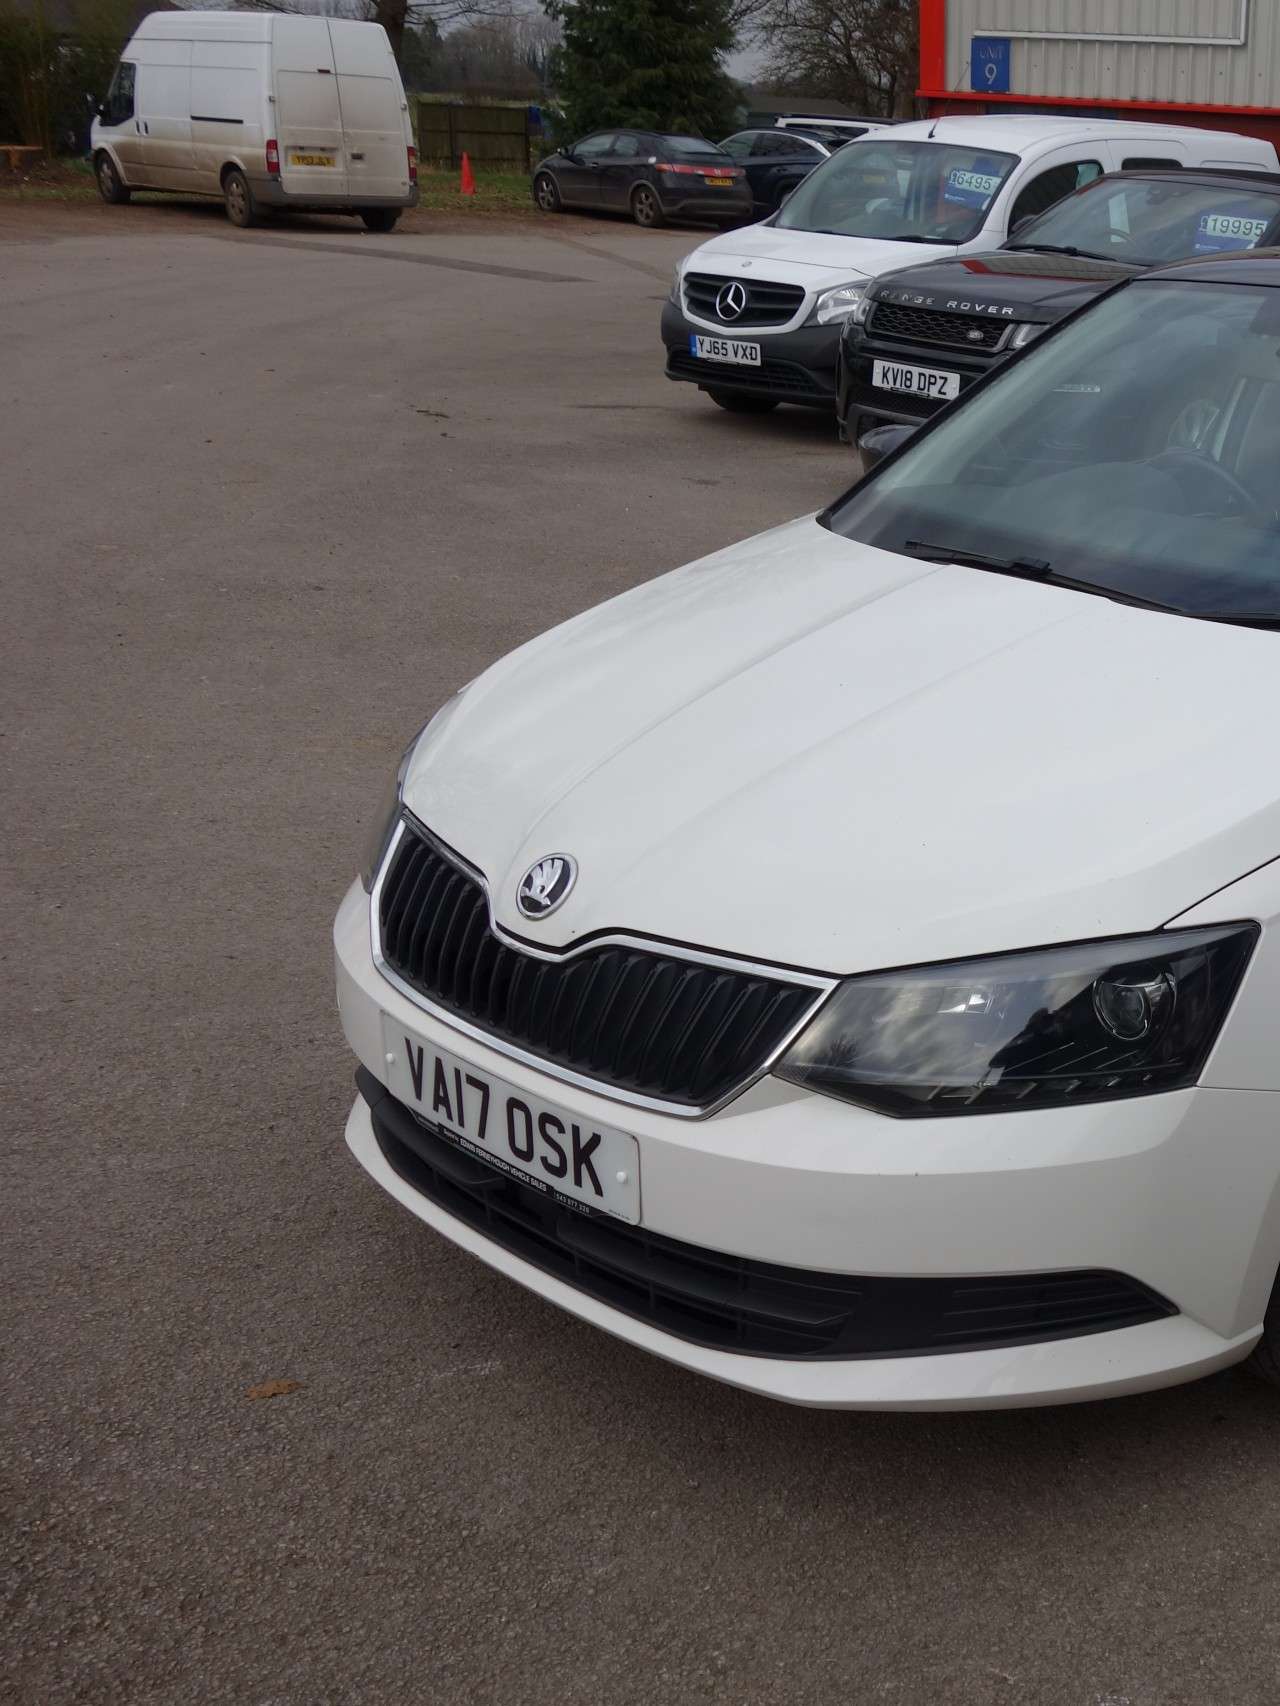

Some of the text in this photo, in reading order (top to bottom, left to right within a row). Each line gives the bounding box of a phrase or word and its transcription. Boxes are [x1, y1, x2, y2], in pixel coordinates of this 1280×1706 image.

[985, 63, 997, 85] 9
[946, 300, 1015, 315] ROVER
[698, 337, 758, 361] YJ65 VXD
[881, 365, 948, 395] KV18 DPZ
[404, 1036, 604, 1198] VA17 OSK
